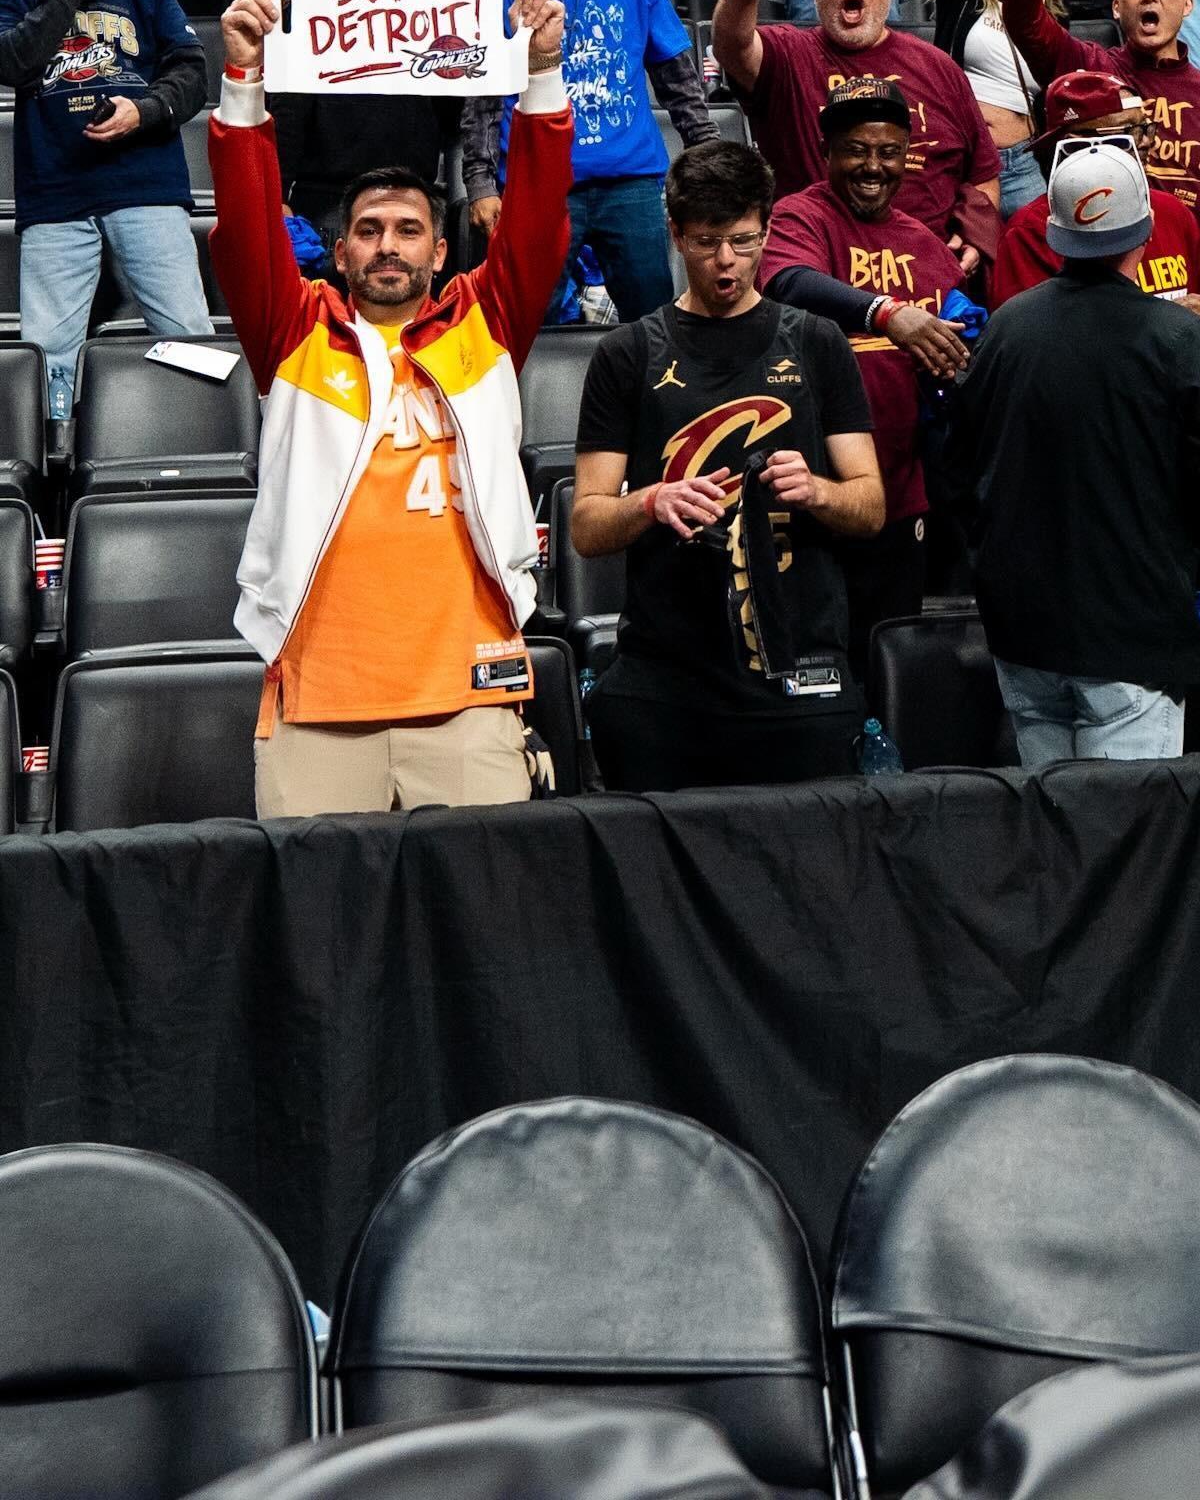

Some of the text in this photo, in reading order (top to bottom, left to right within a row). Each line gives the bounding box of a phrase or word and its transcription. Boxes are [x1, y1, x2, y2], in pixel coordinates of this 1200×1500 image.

[410, 47, 488, 78] CAVALIERS
[849, 246, 916, 293] BEAT
[1138, 254, 1189, 293] LIERS
[766, 374, 802, 383] CLIFFS
